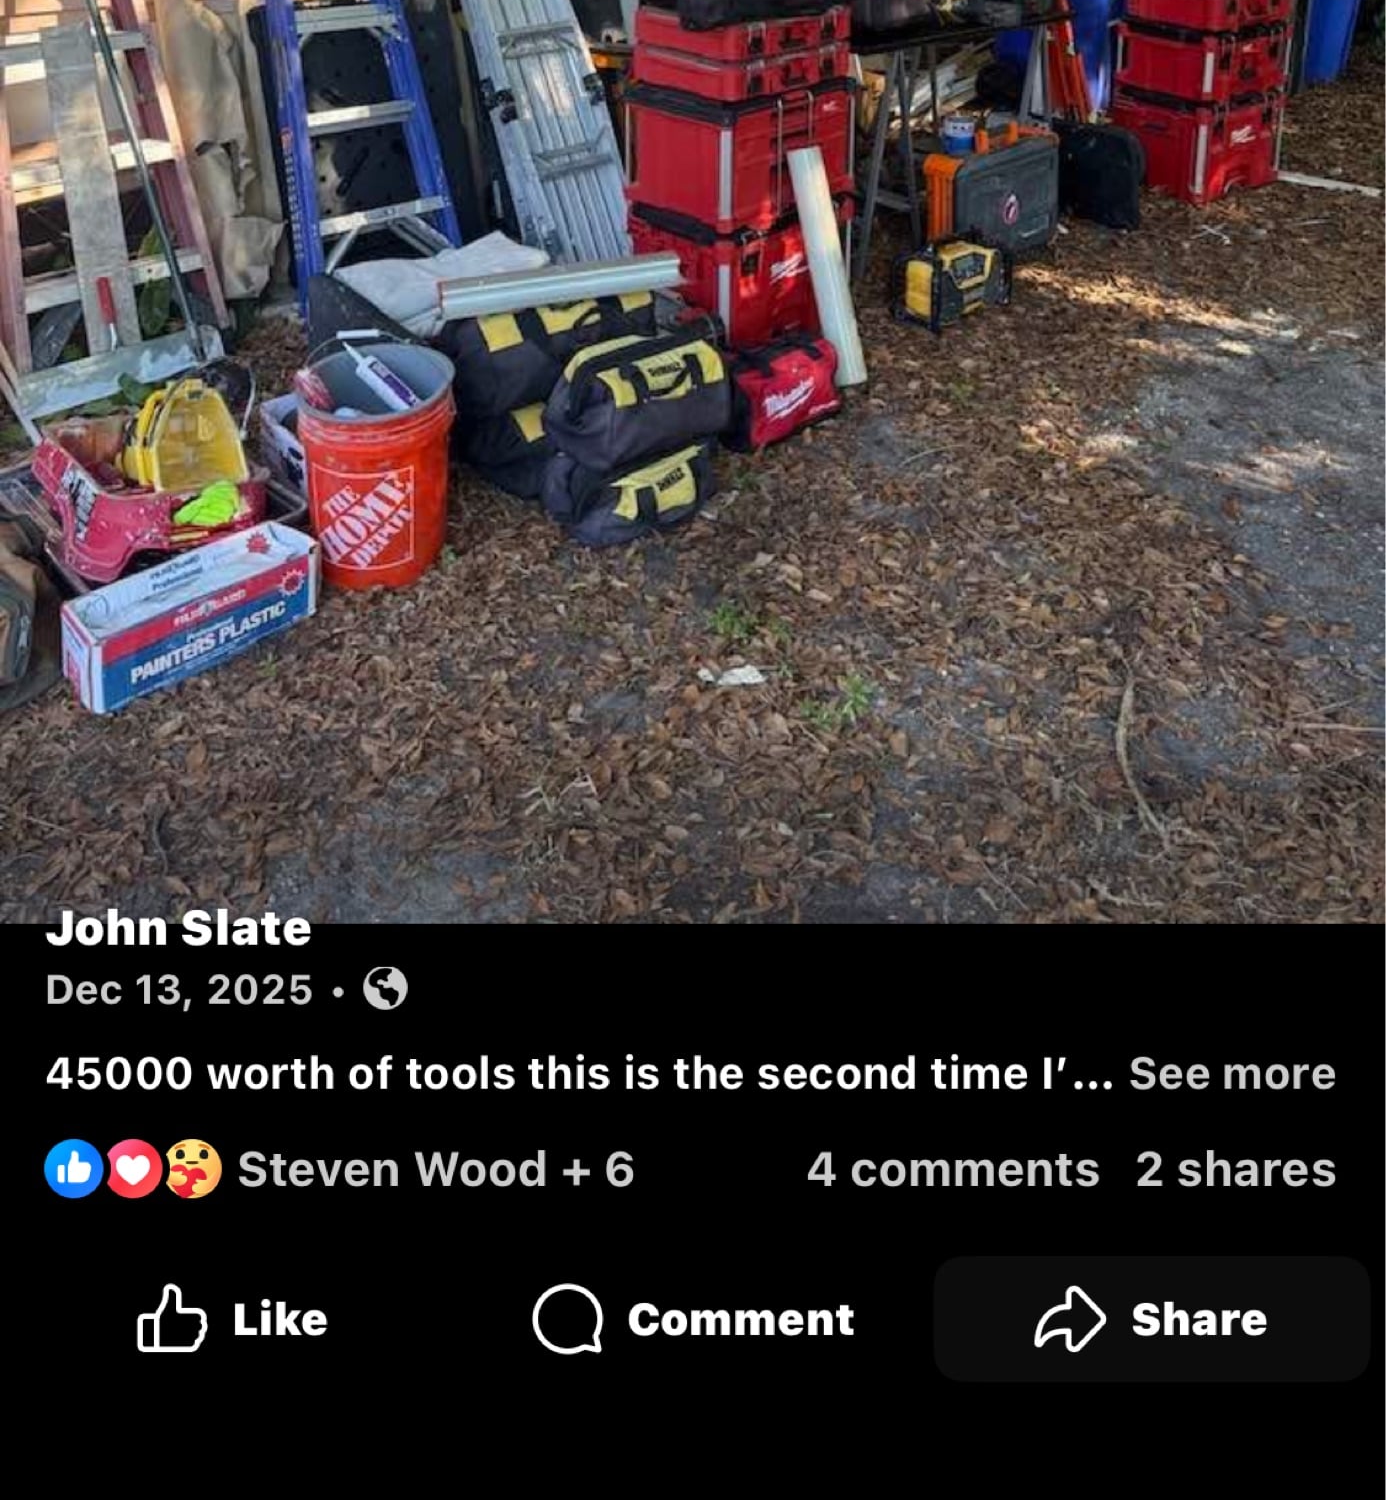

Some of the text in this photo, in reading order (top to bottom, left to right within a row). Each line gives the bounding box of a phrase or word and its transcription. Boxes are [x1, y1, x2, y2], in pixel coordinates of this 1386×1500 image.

[319, 472, 412, 564] HOME
[322, 484, 361, 518] THE
[350, 503, 412, 568] DEPOT
[131, 631, 217, 684] PAINTERS
[219, 600, 287, 645] PLASTIC
